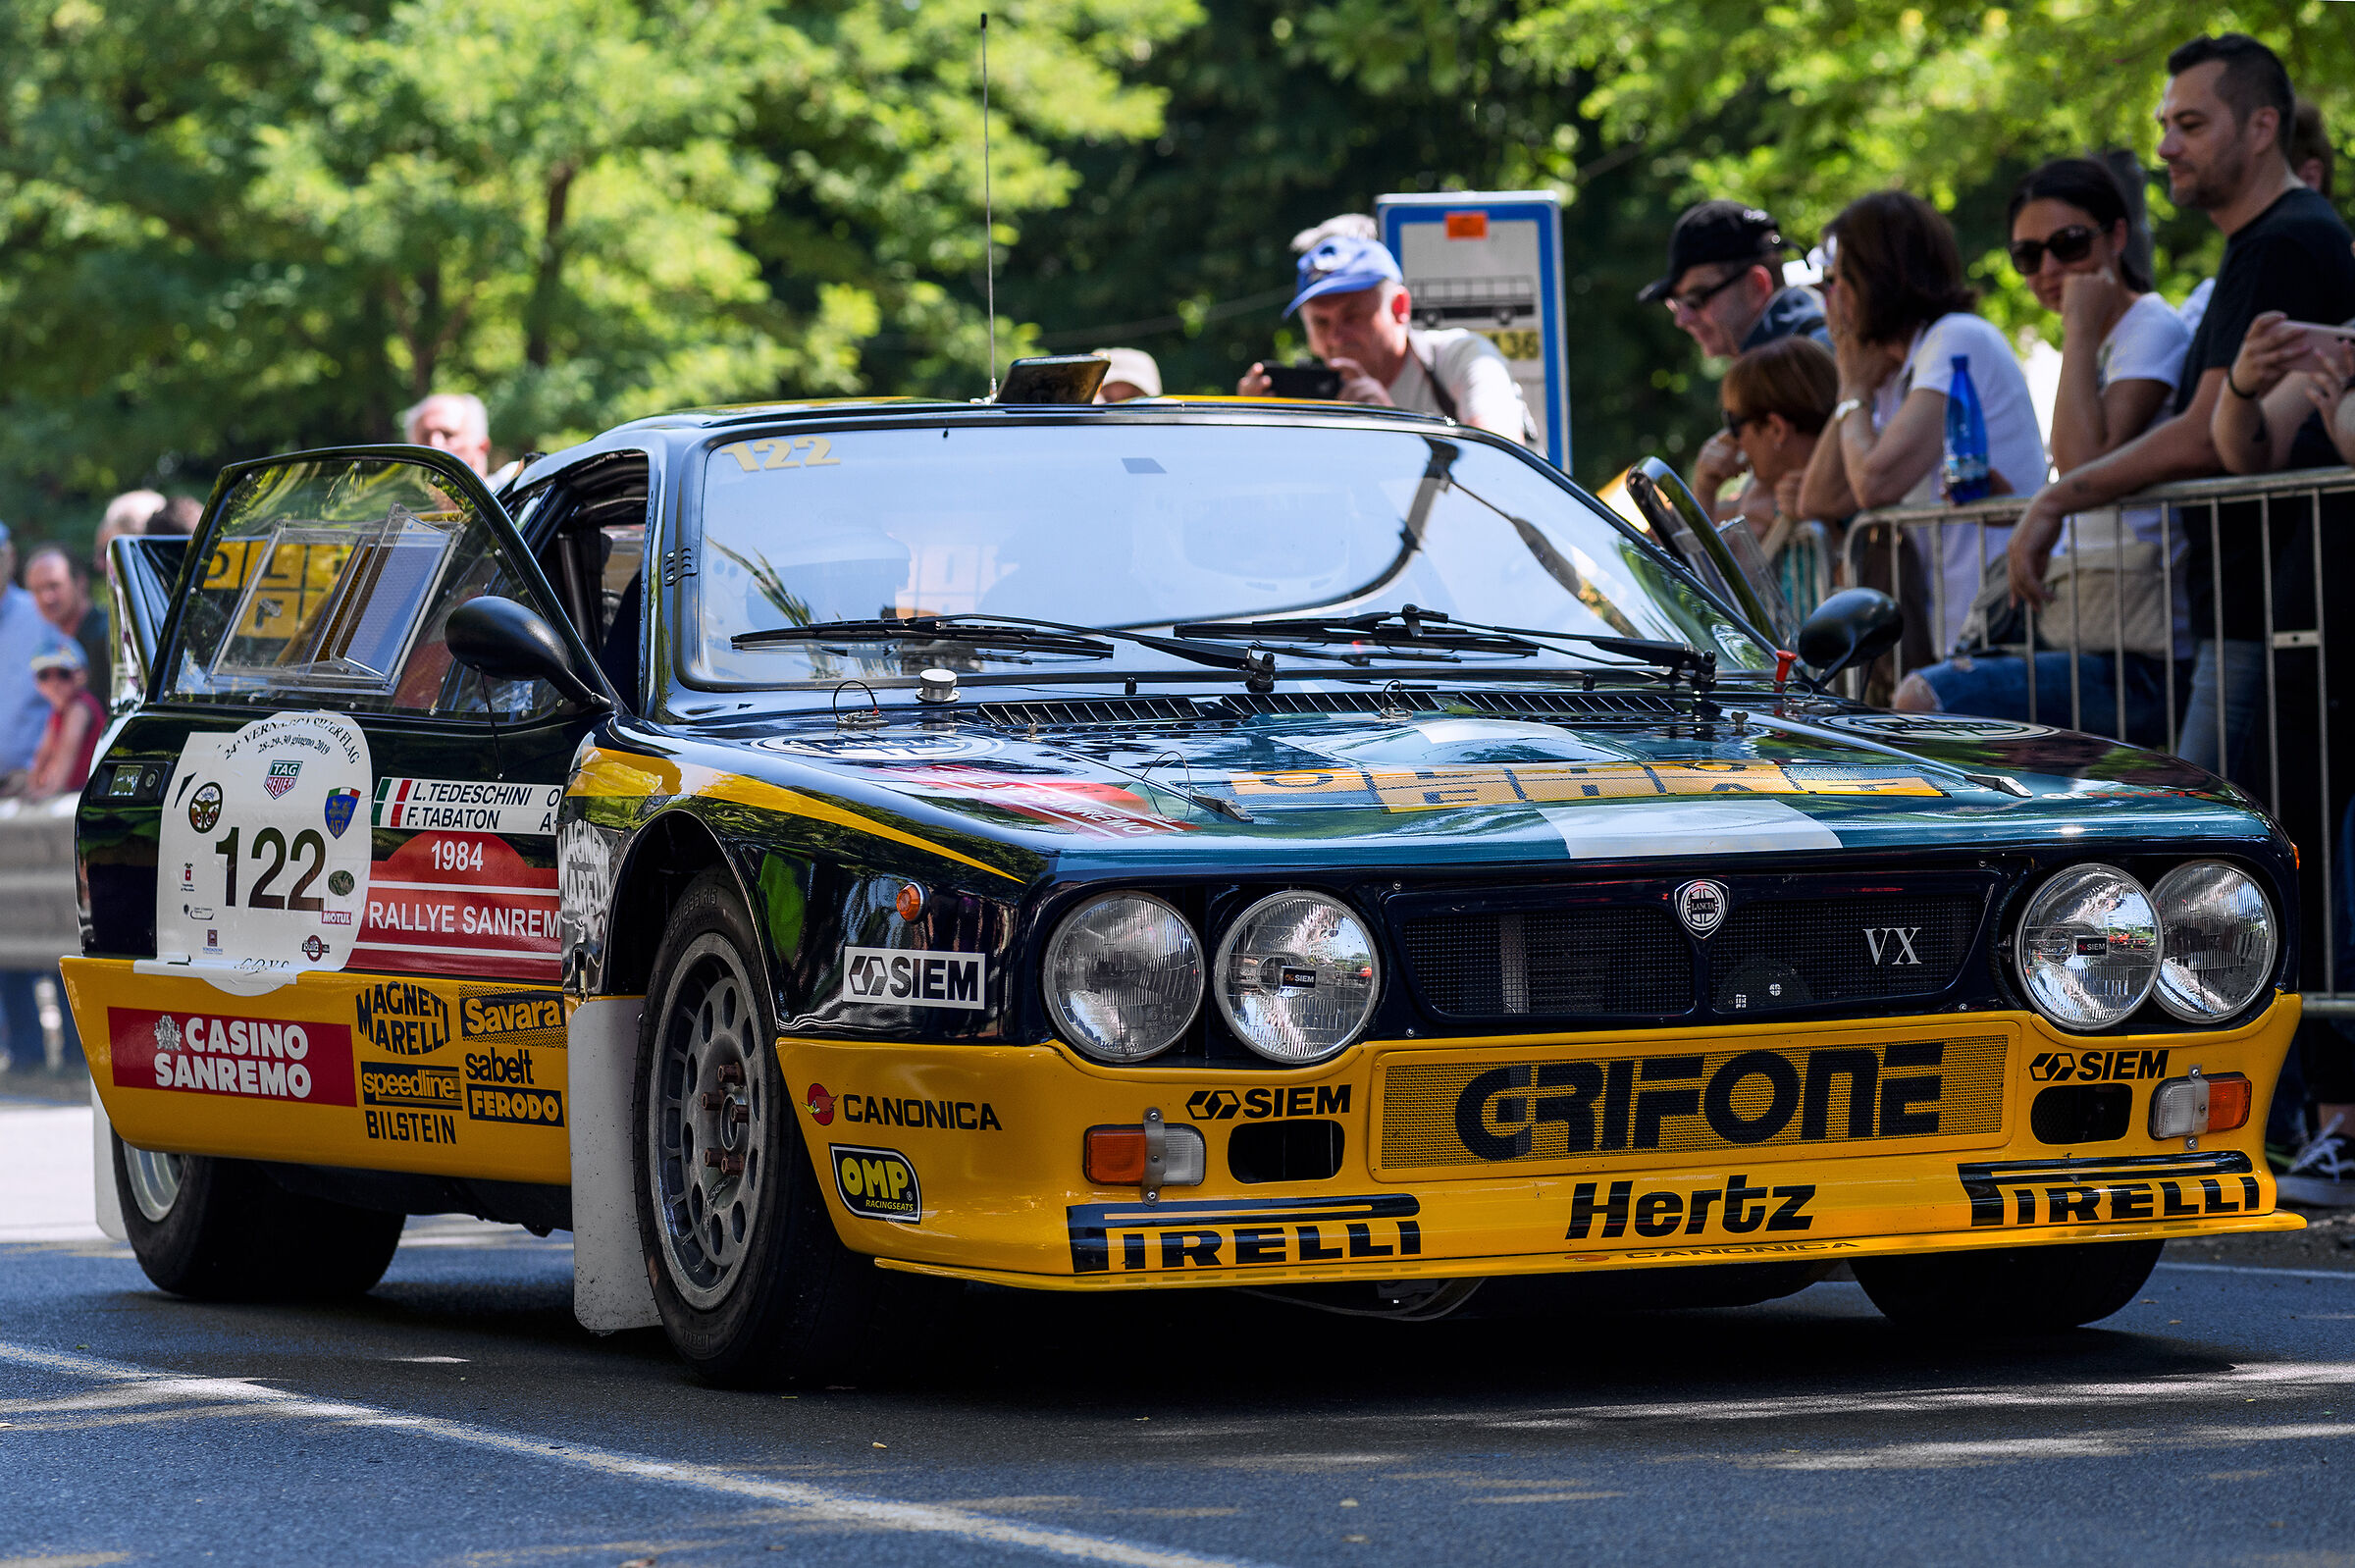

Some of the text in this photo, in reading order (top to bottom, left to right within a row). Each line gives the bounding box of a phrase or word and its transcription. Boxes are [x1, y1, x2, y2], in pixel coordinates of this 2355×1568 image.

[720, 436, 840, 472] 122
[289, 733, 315, 749] giugno
[313, 739, 332, 756] 2019
[339, 731, 360, 764] FLAG
[266, 777, 295, 797] HEUER
[273, 763, 298, 776] TAG
[412, 782, 533, 808] L.TEDESCHINI
[405, 807, 501, 831] F.TABATON
[215, 826, 326, 913] 122
[430, 840, 485, 872] 1984
[323, 912, 351, 924] MOTUL
[368, 901, 456, 934] RALLYE
[1691, 901, 1716, 912] LANCIA
[1862, 926, 1922, 966] VX
[2086, 942, 2107, 952] SIEM
[889, 956, 979, 1002] SIEM
[1294, 973, 1316, 984] SIEM
[355, 981, 449, 1021] MAGNETI
[464, 998, 562, 1034] Savara
[184, 1017, 310, 1061] CASINO
[357, 1017, 451, 1056] MARELLI
[153, 1052, 312, 1099] SANREMO
[464, 1046, 536, 1085] sabelt
[2076, 1049, 2170, 1081] SIEM
[362, 1069, 456, 1102] speedline
[1242, 1083, 1352, 1120] SIEM
[1453, 1041, 1946, 1162] GRIFONE
[470, 1089, 560, 1123] FERODO
[843, 1094, 1003, 1131] CANONICA
[365, 1110, 457, 1145] BILSTEIN
[840, 1157, 910, 1201] OMP
[1957, 1150, 2261, 1228] PIRELLI
[864, 1198, 915, 1213] RACINGSEATS
[1564, 1173, 1817, 1241] Hertz
[1066, 1192, 1422, 1274] PIRELLI
[1624, 1241, 1860, 1260] CANONICA
